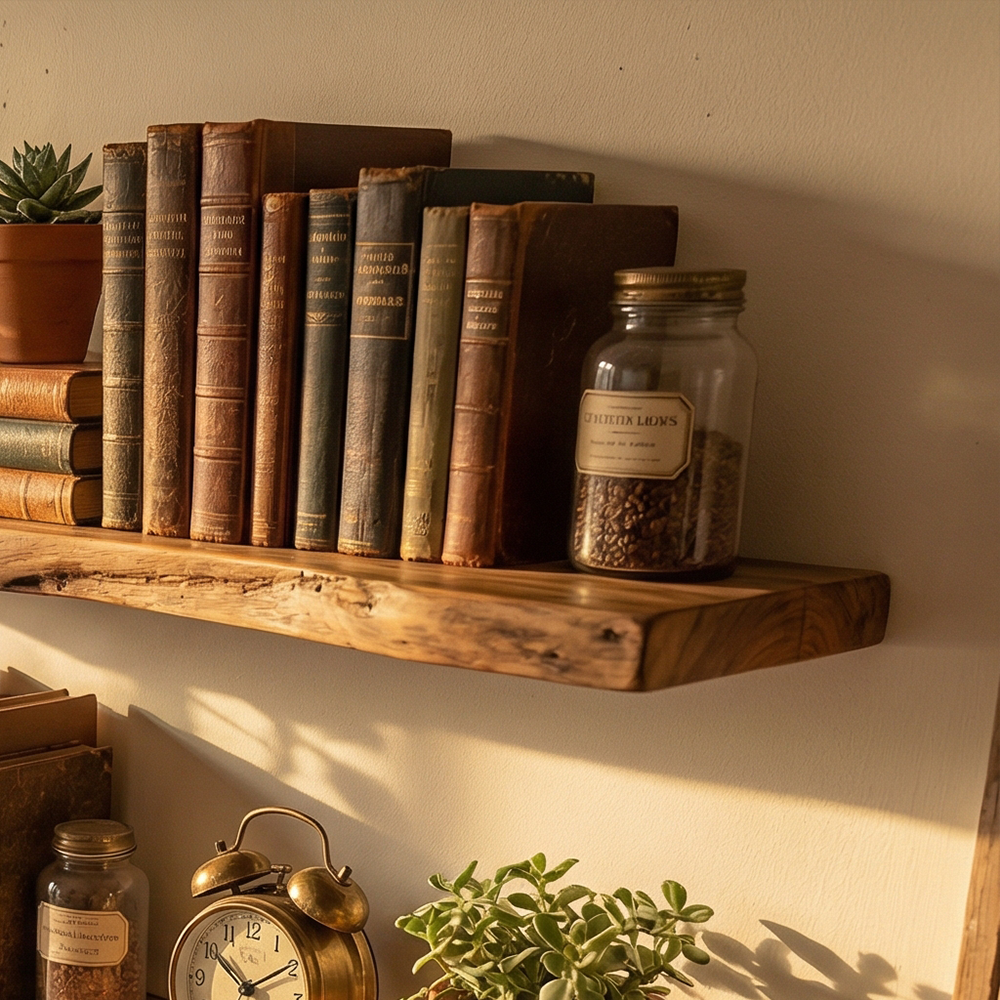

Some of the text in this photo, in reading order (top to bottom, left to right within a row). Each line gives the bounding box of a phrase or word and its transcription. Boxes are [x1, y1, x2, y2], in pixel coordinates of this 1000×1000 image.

[223, 924, 235, 947] 11
[246, 921, 262, 940] 12
[204, 941, 219, 960] 10
[274, 935, 280, 952] 1
[287, 959, 299, 977] 2
[195, 969, 205, 986] 9
